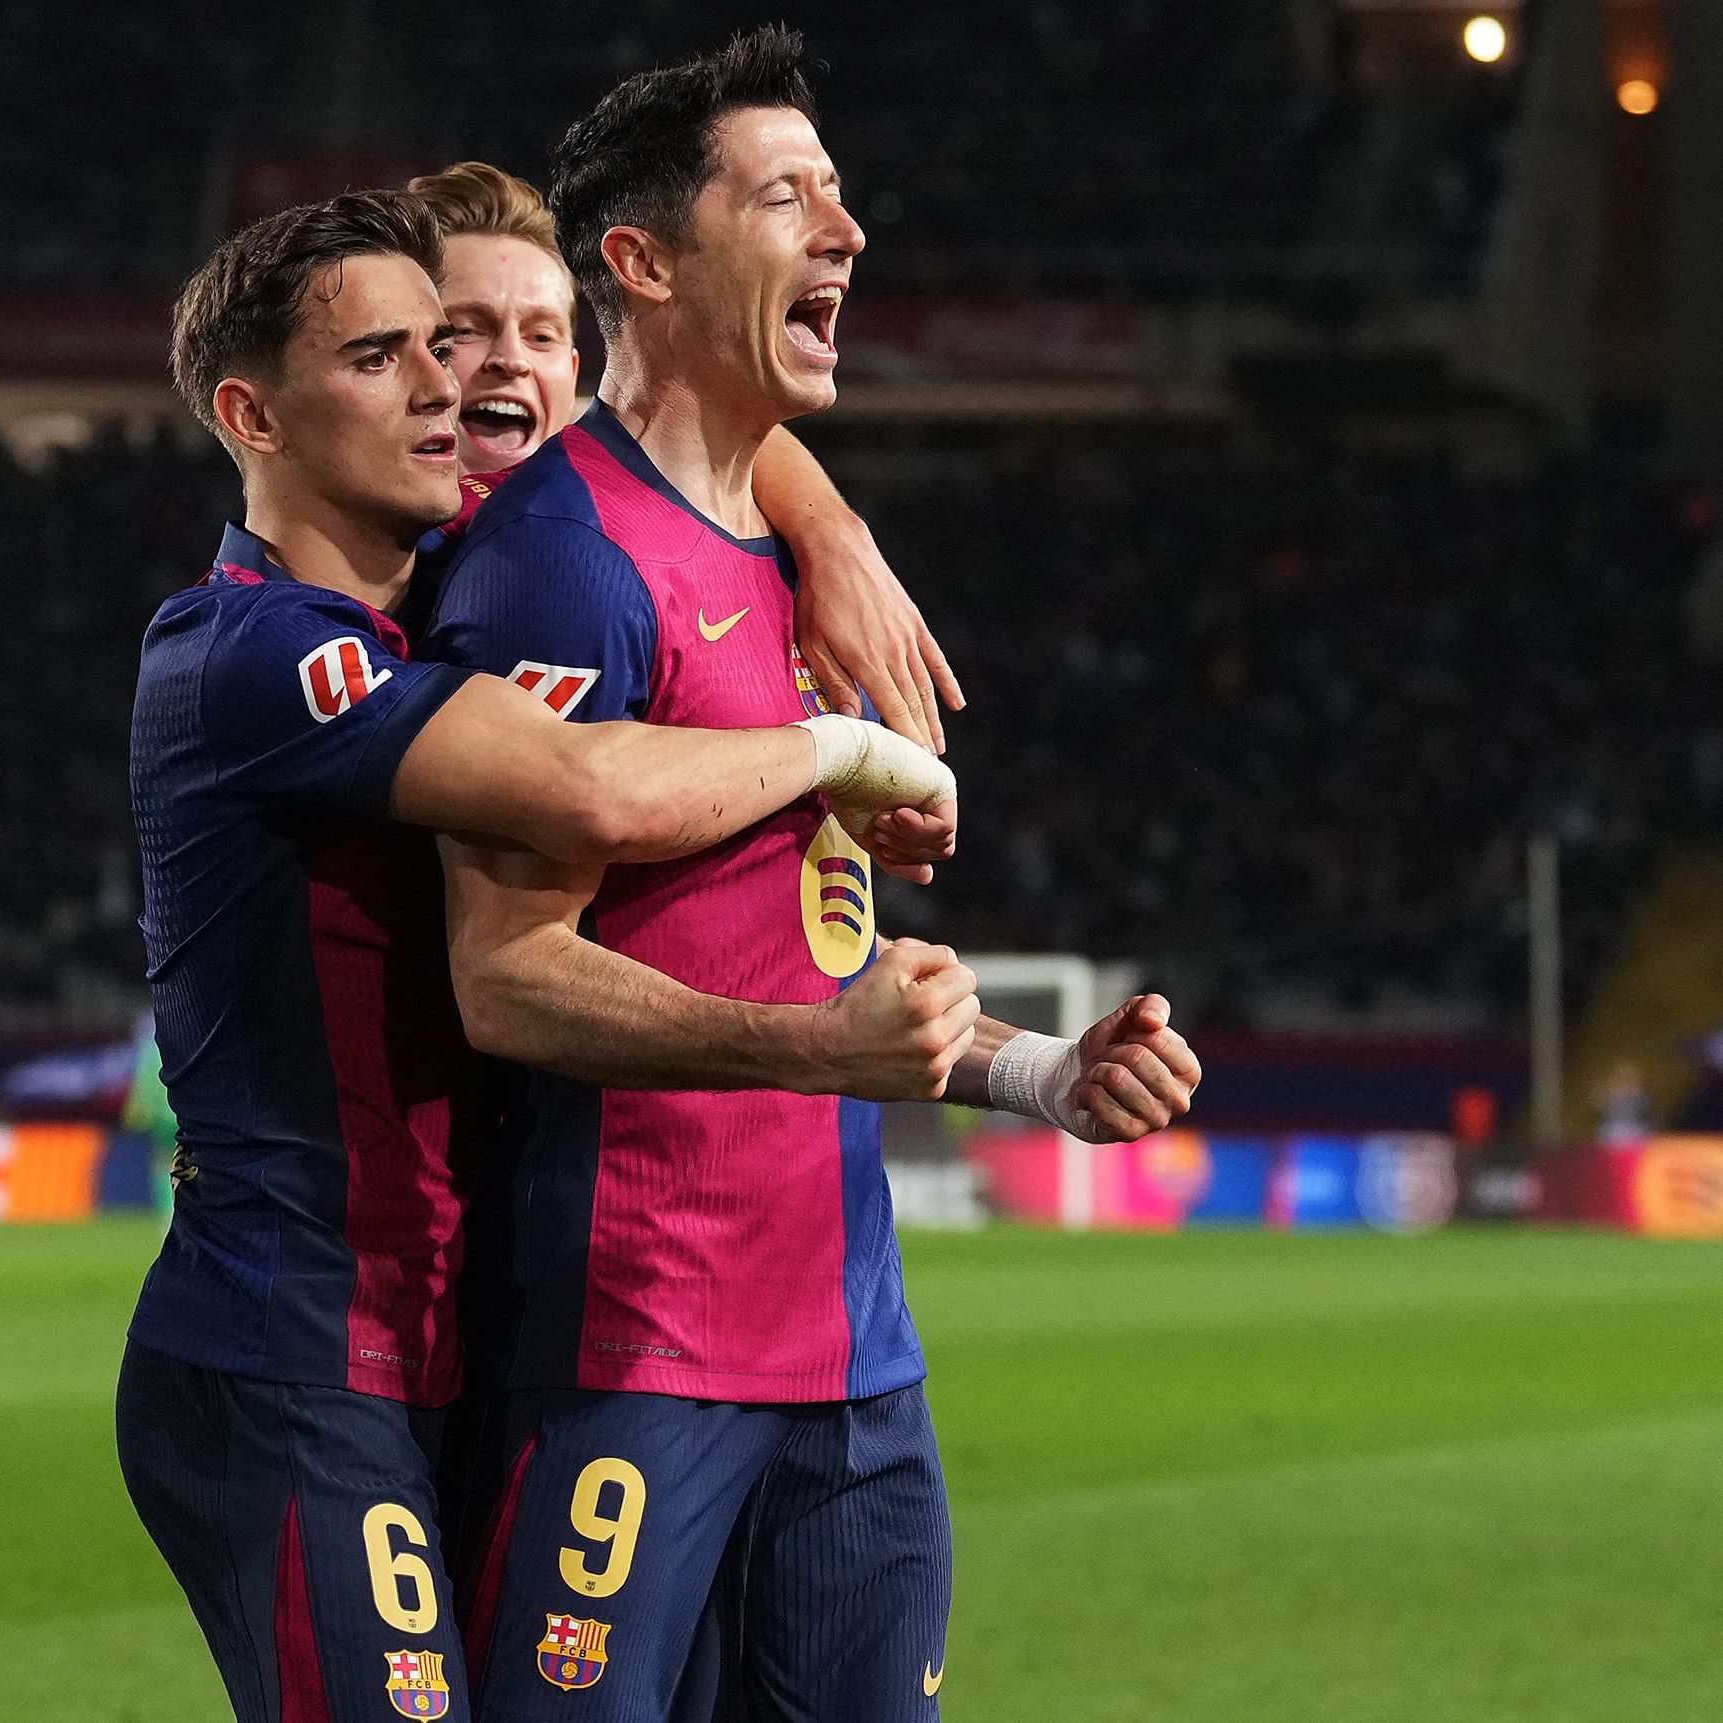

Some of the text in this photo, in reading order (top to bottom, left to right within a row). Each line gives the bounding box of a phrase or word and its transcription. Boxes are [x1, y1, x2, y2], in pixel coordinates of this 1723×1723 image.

[557, 1456, 648, 1598] 9
[362, 1502, 439, 1635] 6
[407, 1680, 432, 1689] FCB
[559, 1645, 587, 1658] FCB
